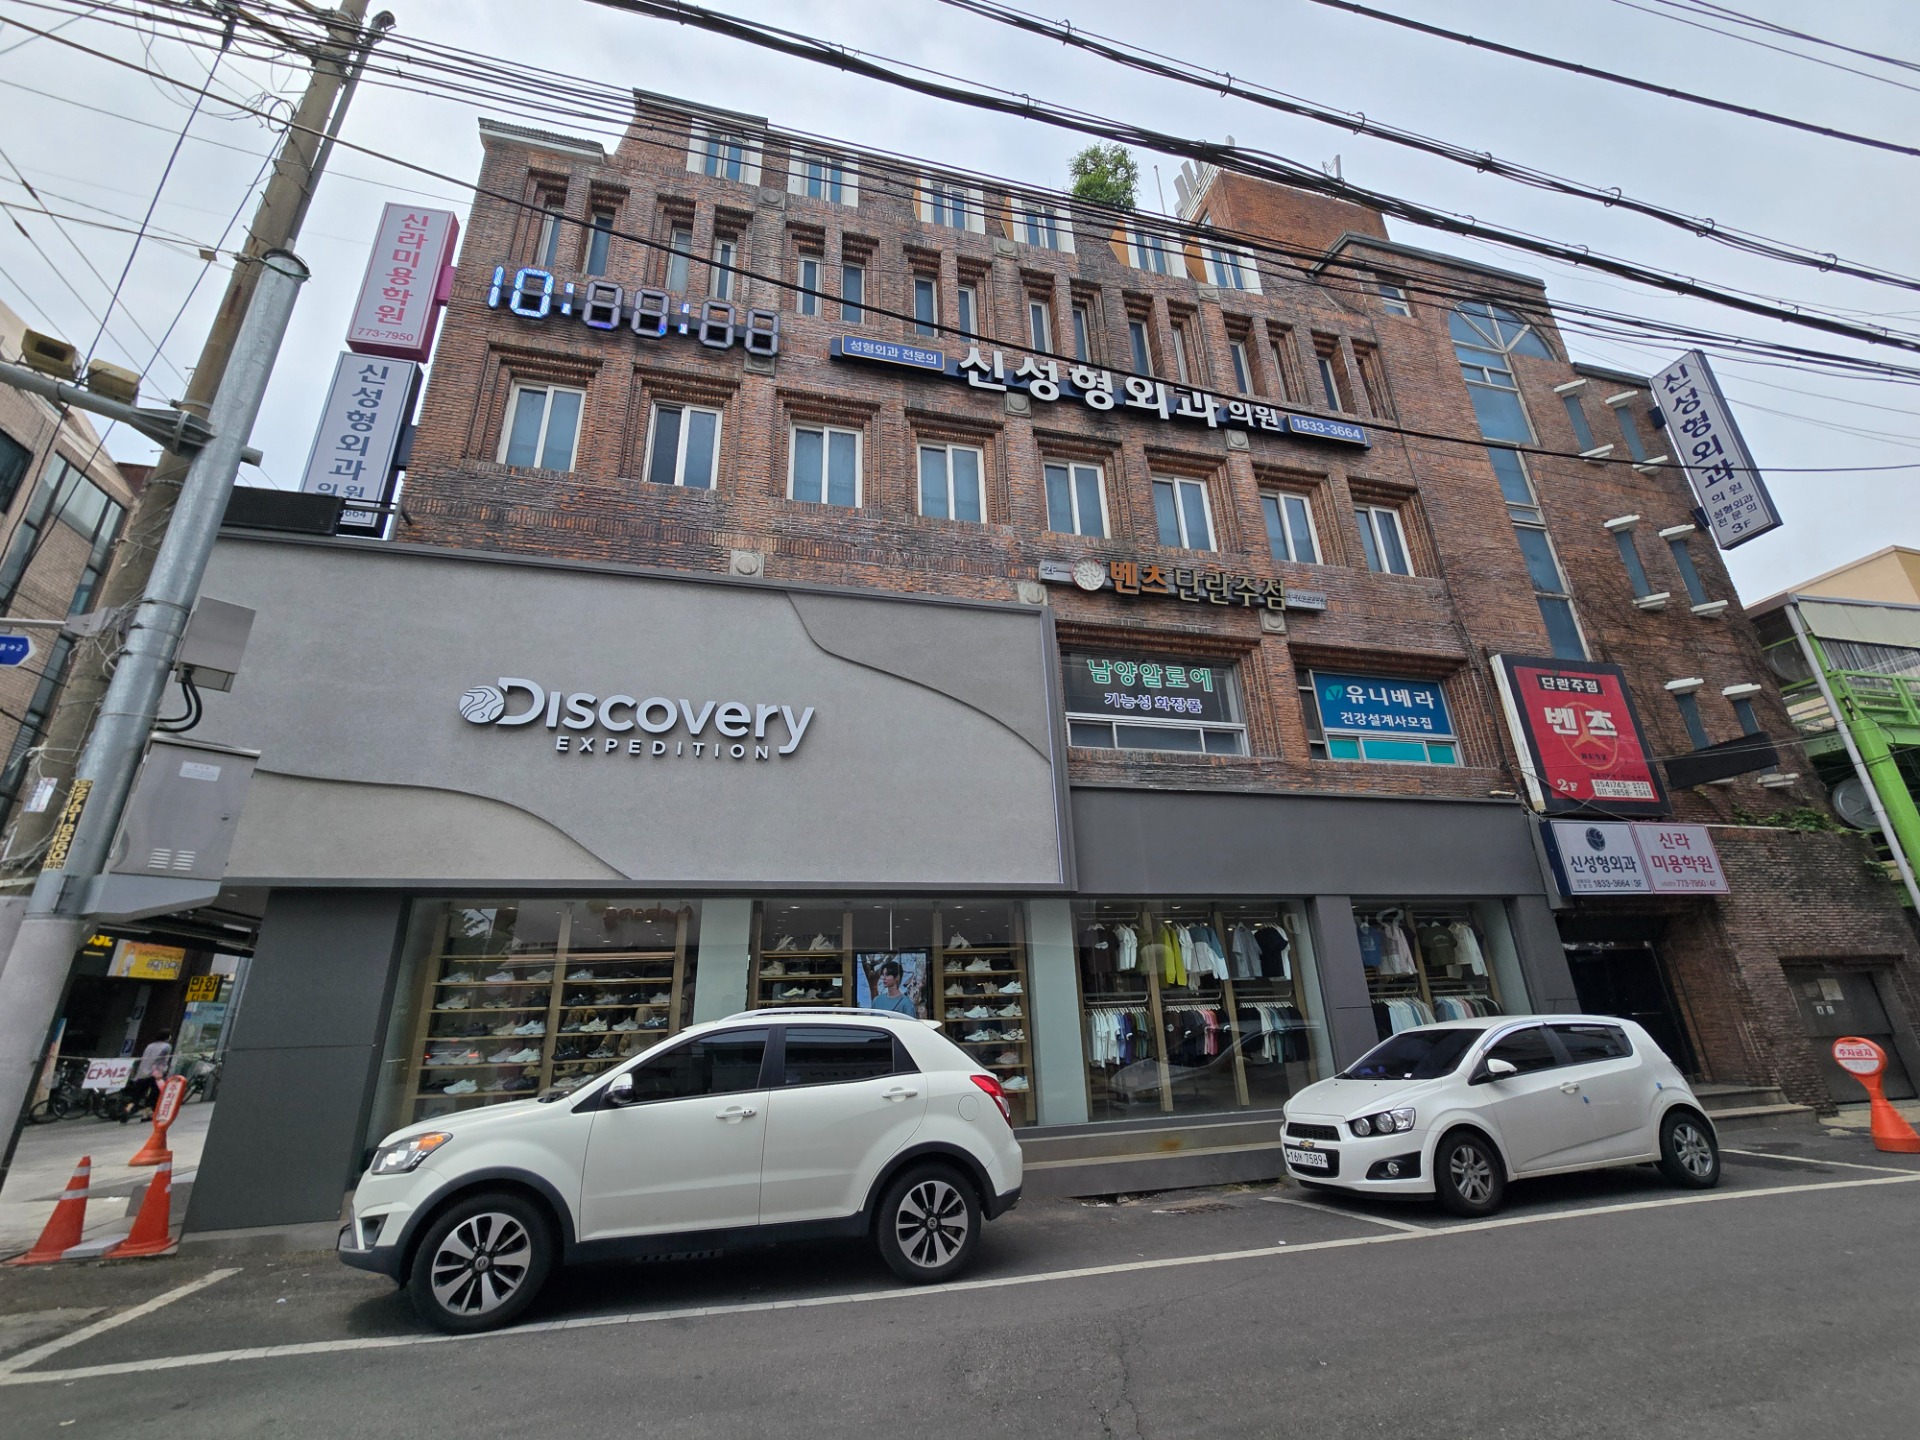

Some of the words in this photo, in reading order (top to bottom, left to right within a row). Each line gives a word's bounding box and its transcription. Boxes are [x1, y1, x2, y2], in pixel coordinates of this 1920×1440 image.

[356, 326, 415, 343] 773-7950
[850, 338, 899, 359] 성형외과
[900, 347, 938, 366] 전문의
[958, 346, 1221, 429] 신성형외과
[1228, 400, 1283, 432] 의원
[327, 362, 391, 482] 신성형외과
[1292, 416, 1362, 442] 1833-3664
[1662, 363, 1735, 489] 신성형외과
[1711, 481, 1744, 505] 의원
[1731, 519, 1752, 534] 3F
[1109, 560, 1169, 595] 벤츠
[1172, 567, 1287, 611] 단란주점
[1086, 658, 1214, 693] 남양알로에
[1541, 676, 1599, 693] 단란주점
[1104, 691, 1152, 711] 기능성
[1154, 695, 1203, 714] 화장품
[1345, 684, 1435, 710] 유니베라
[555, 735, 769, 760] EXPEDITION
[1556, 778, 1579, 792] 2F
[1659, 832, 1691, 850] 신라
[1570, 854, 1638, 874] 신성형외과
[1650, 854, 1715, 874] 미용학원
